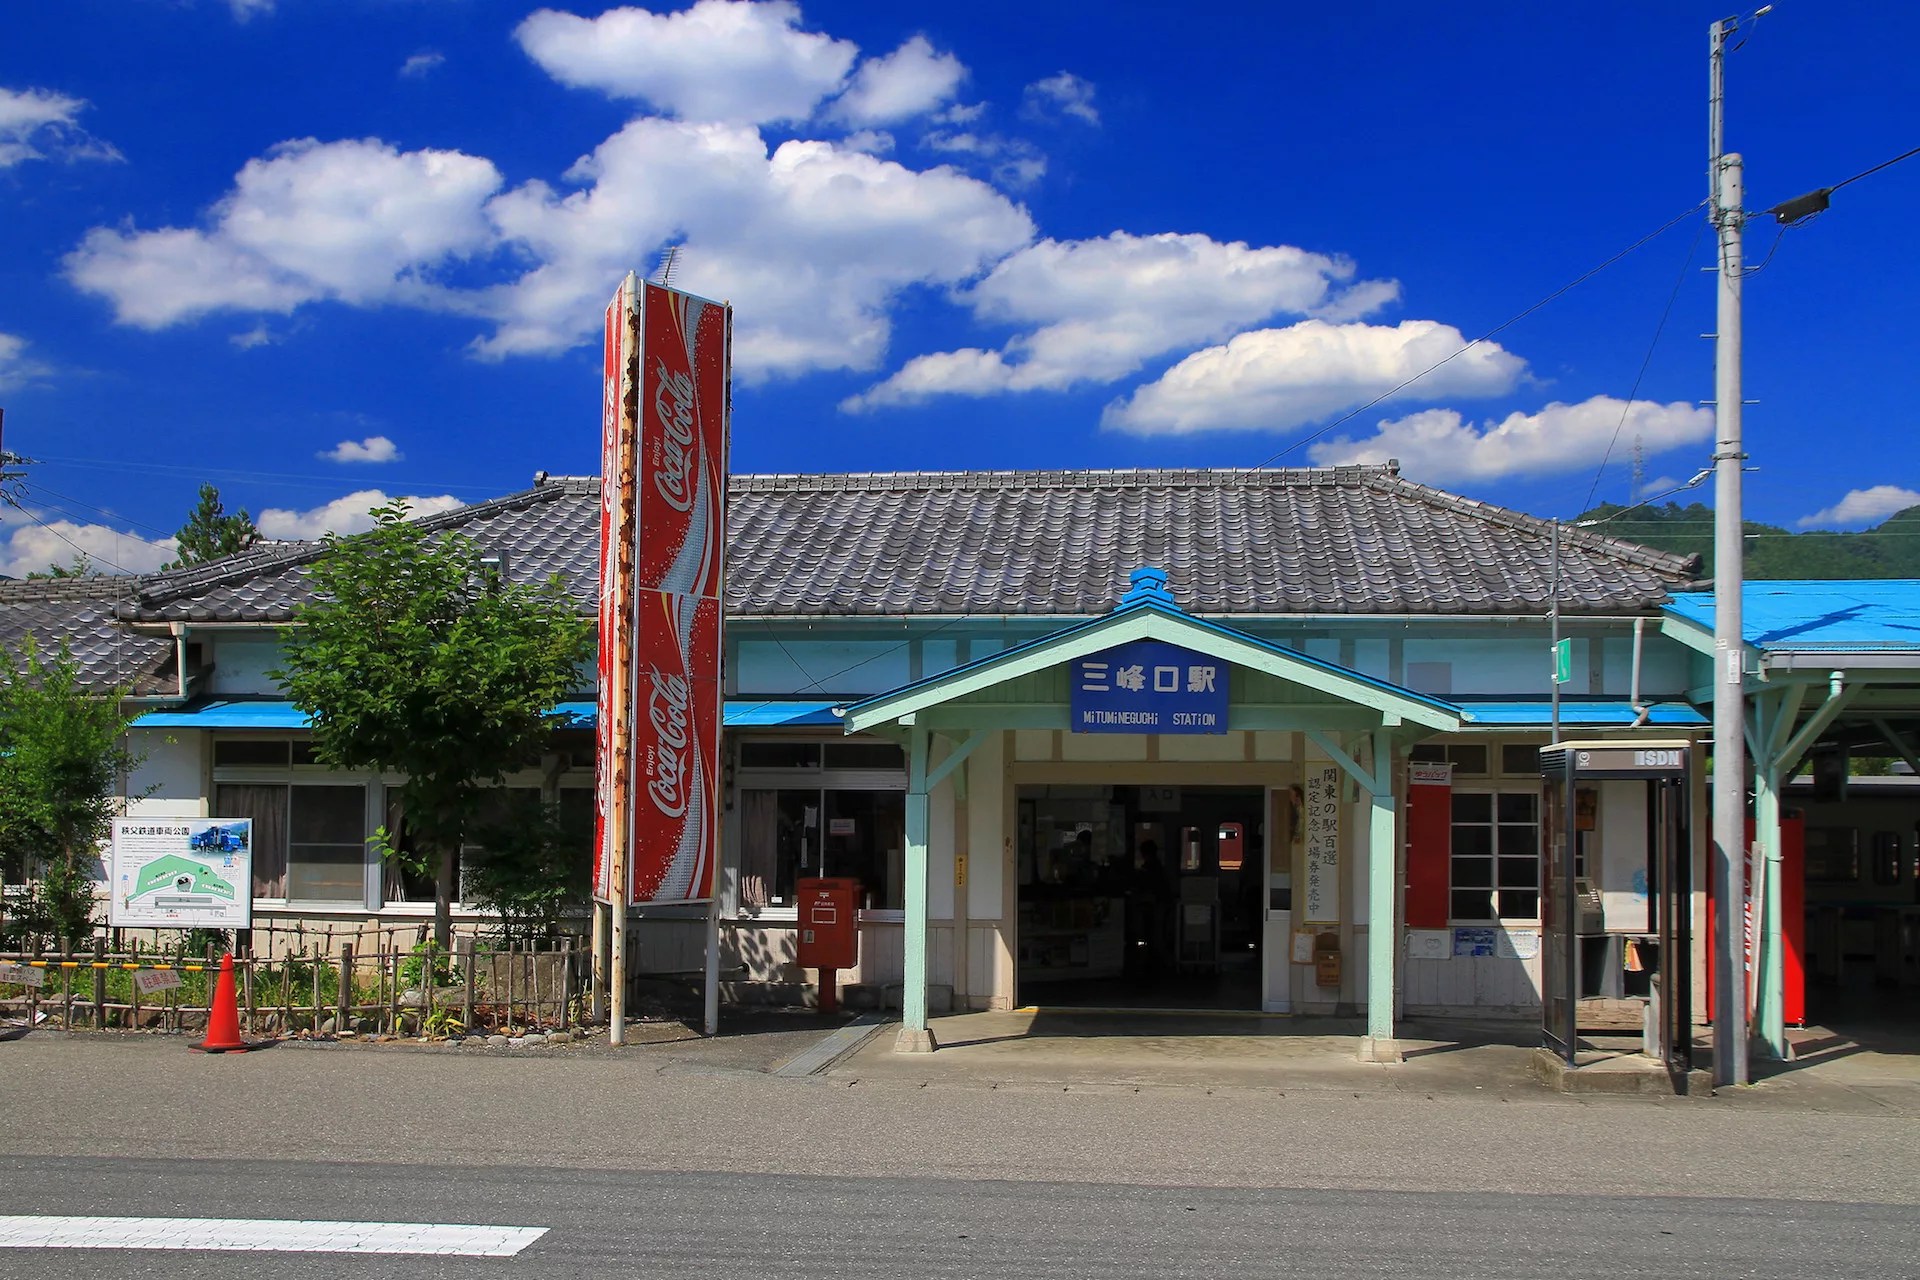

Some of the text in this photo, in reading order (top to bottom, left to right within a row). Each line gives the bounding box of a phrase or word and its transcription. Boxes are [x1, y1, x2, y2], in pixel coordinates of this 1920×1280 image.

[653, 356, 695, 513] Coca-Cola
[652, 436, 662, 467] Enjoy!
[1082, 662, 1216, 693] 三峰口駅
[647, 661, 688, 819] Coca-Cola
[645, 744, 655, 777] Enjoy!
[1634, 750, 1680, 766] ISDN
[121, 826, 190, 836] 秩父鉄道車両公園
[1322, 767, 1338, 866] 関東の駅百選
[1308, 776, 1321, 916] 認定記念入場券発売中
[141, 973, 181, 989] 駐車禁止
